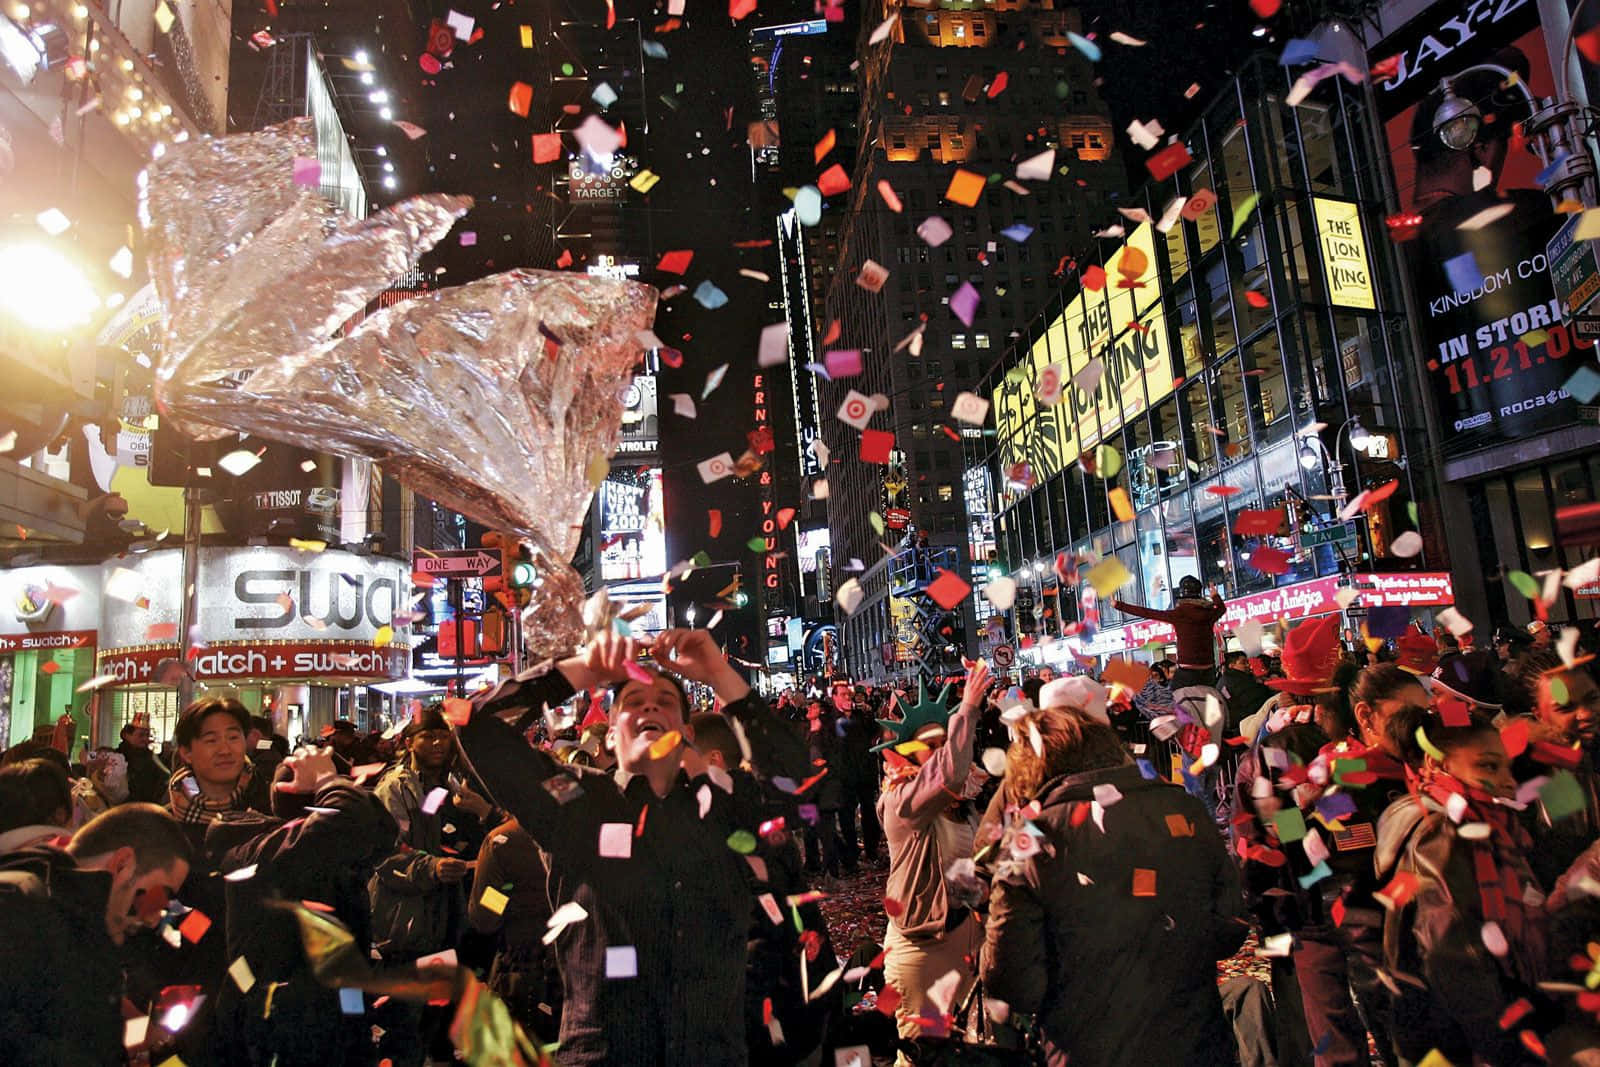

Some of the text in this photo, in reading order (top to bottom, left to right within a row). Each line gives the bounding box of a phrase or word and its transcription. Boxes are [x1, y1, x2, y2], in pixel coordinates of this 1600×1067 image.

[575, 188, 622, 198] TARGET
[1327, 219, 1353, 235] THE
[1326, 238, 1361, 262] LION
[1331, 266, 1367, 291] KING
[1078, 301, 1109, 350] THE
[1439, 334, 1469, 363] IN
[1101, 318, 1160, 410] KING
[602, 441, 658, 453] VROLET
[608, 481, 645, 498] HAPPY
[754, 375, 778, 588] ERN & YOUNG
[269, 489, 301, 508] TISSOT
[608, 493, 637, 506] NEW
[608, 503, 640, 516] YEAR
[608, 514, 646, 531] 2007
[1313, 534, 1319, 544] 7
[425, 558, 492, 570] ONE WAY
